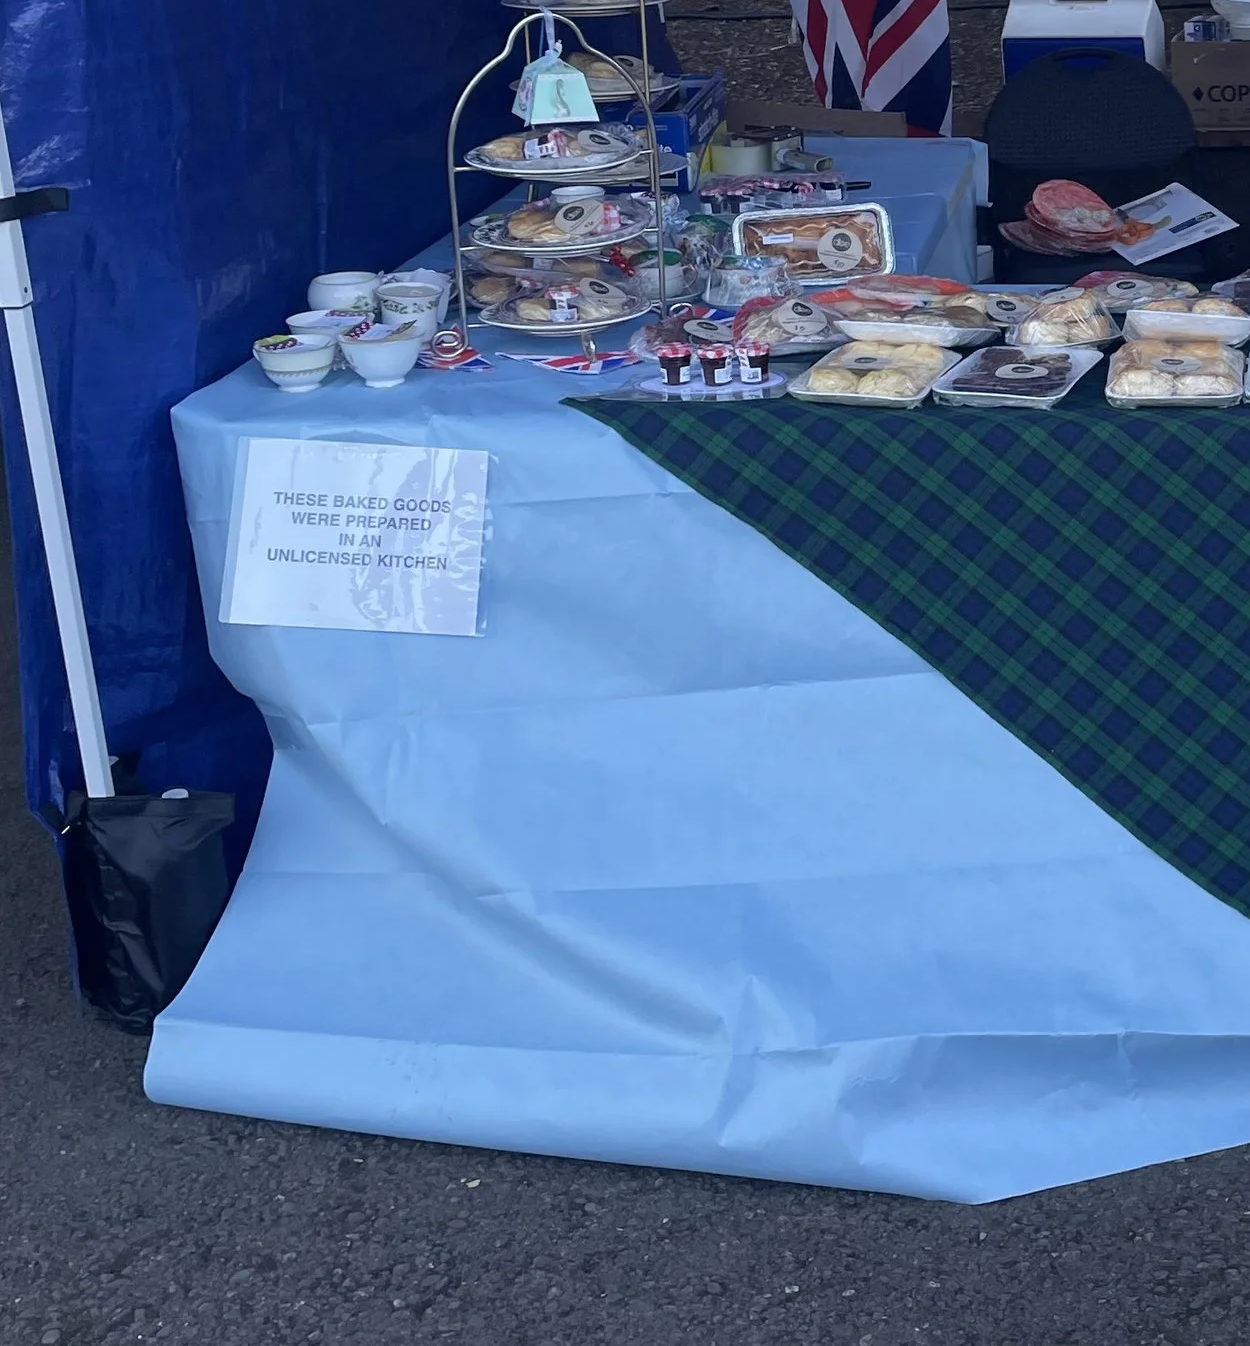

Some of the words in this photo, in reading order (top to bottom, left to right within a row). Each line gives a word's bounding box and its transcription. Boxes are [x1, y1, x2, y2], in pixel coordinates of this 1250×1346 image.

[274, 491, 328, 507] THESE
[333, 495, 388, 510] BAKED
[393, 498, 451, 514] GOODS
[291, 511, 341, 527] WERE
[345, 515, 432, 531] PREPARED
[339, 532, 354, 546] IN
[359, 533, 382, 548] AN
[267, 548, 372, 566] UNLICENSED
[377, 554, 447, 570] KITCHEN
